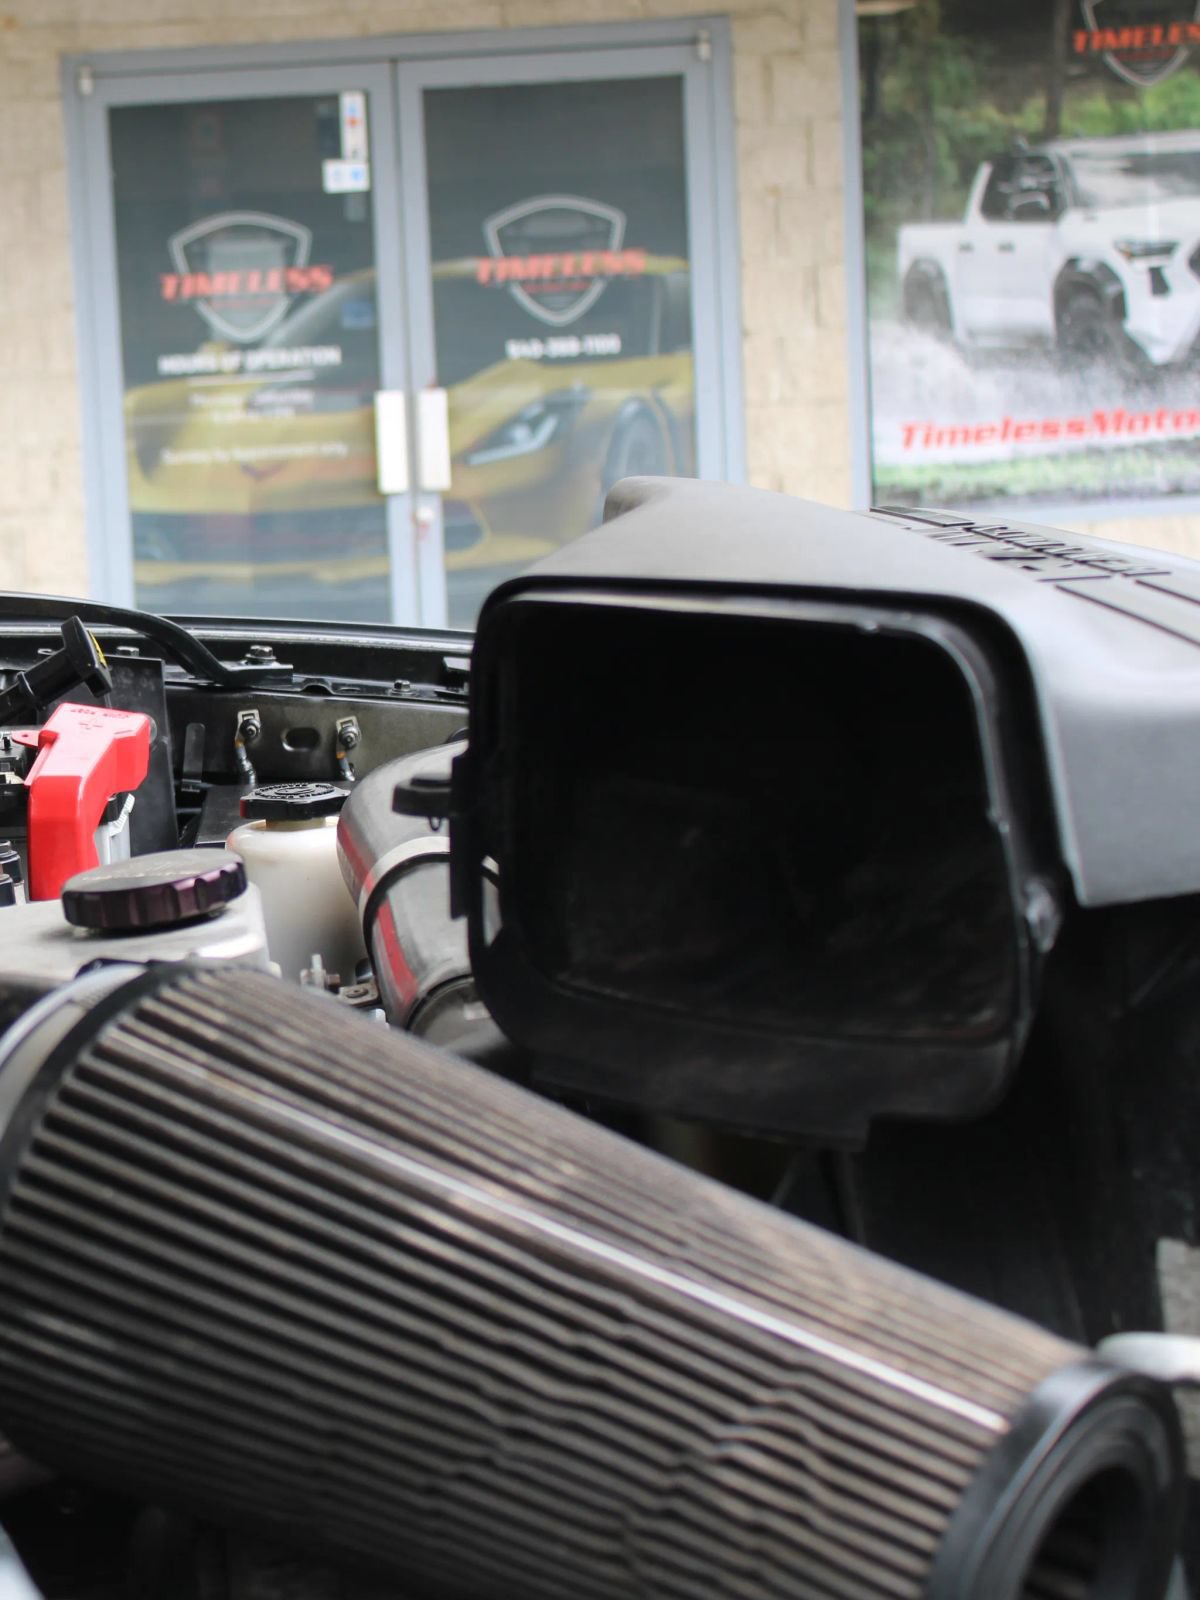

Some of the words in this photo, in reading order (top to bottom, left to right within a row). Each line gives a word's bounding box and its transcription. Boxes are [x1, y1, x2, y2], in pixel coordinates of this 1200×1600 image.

[160, 264, 333, 302] TIMELESS
[475, 248, 648, 285] TIMELESS
[245, 346, 342, 371] OPERATION
